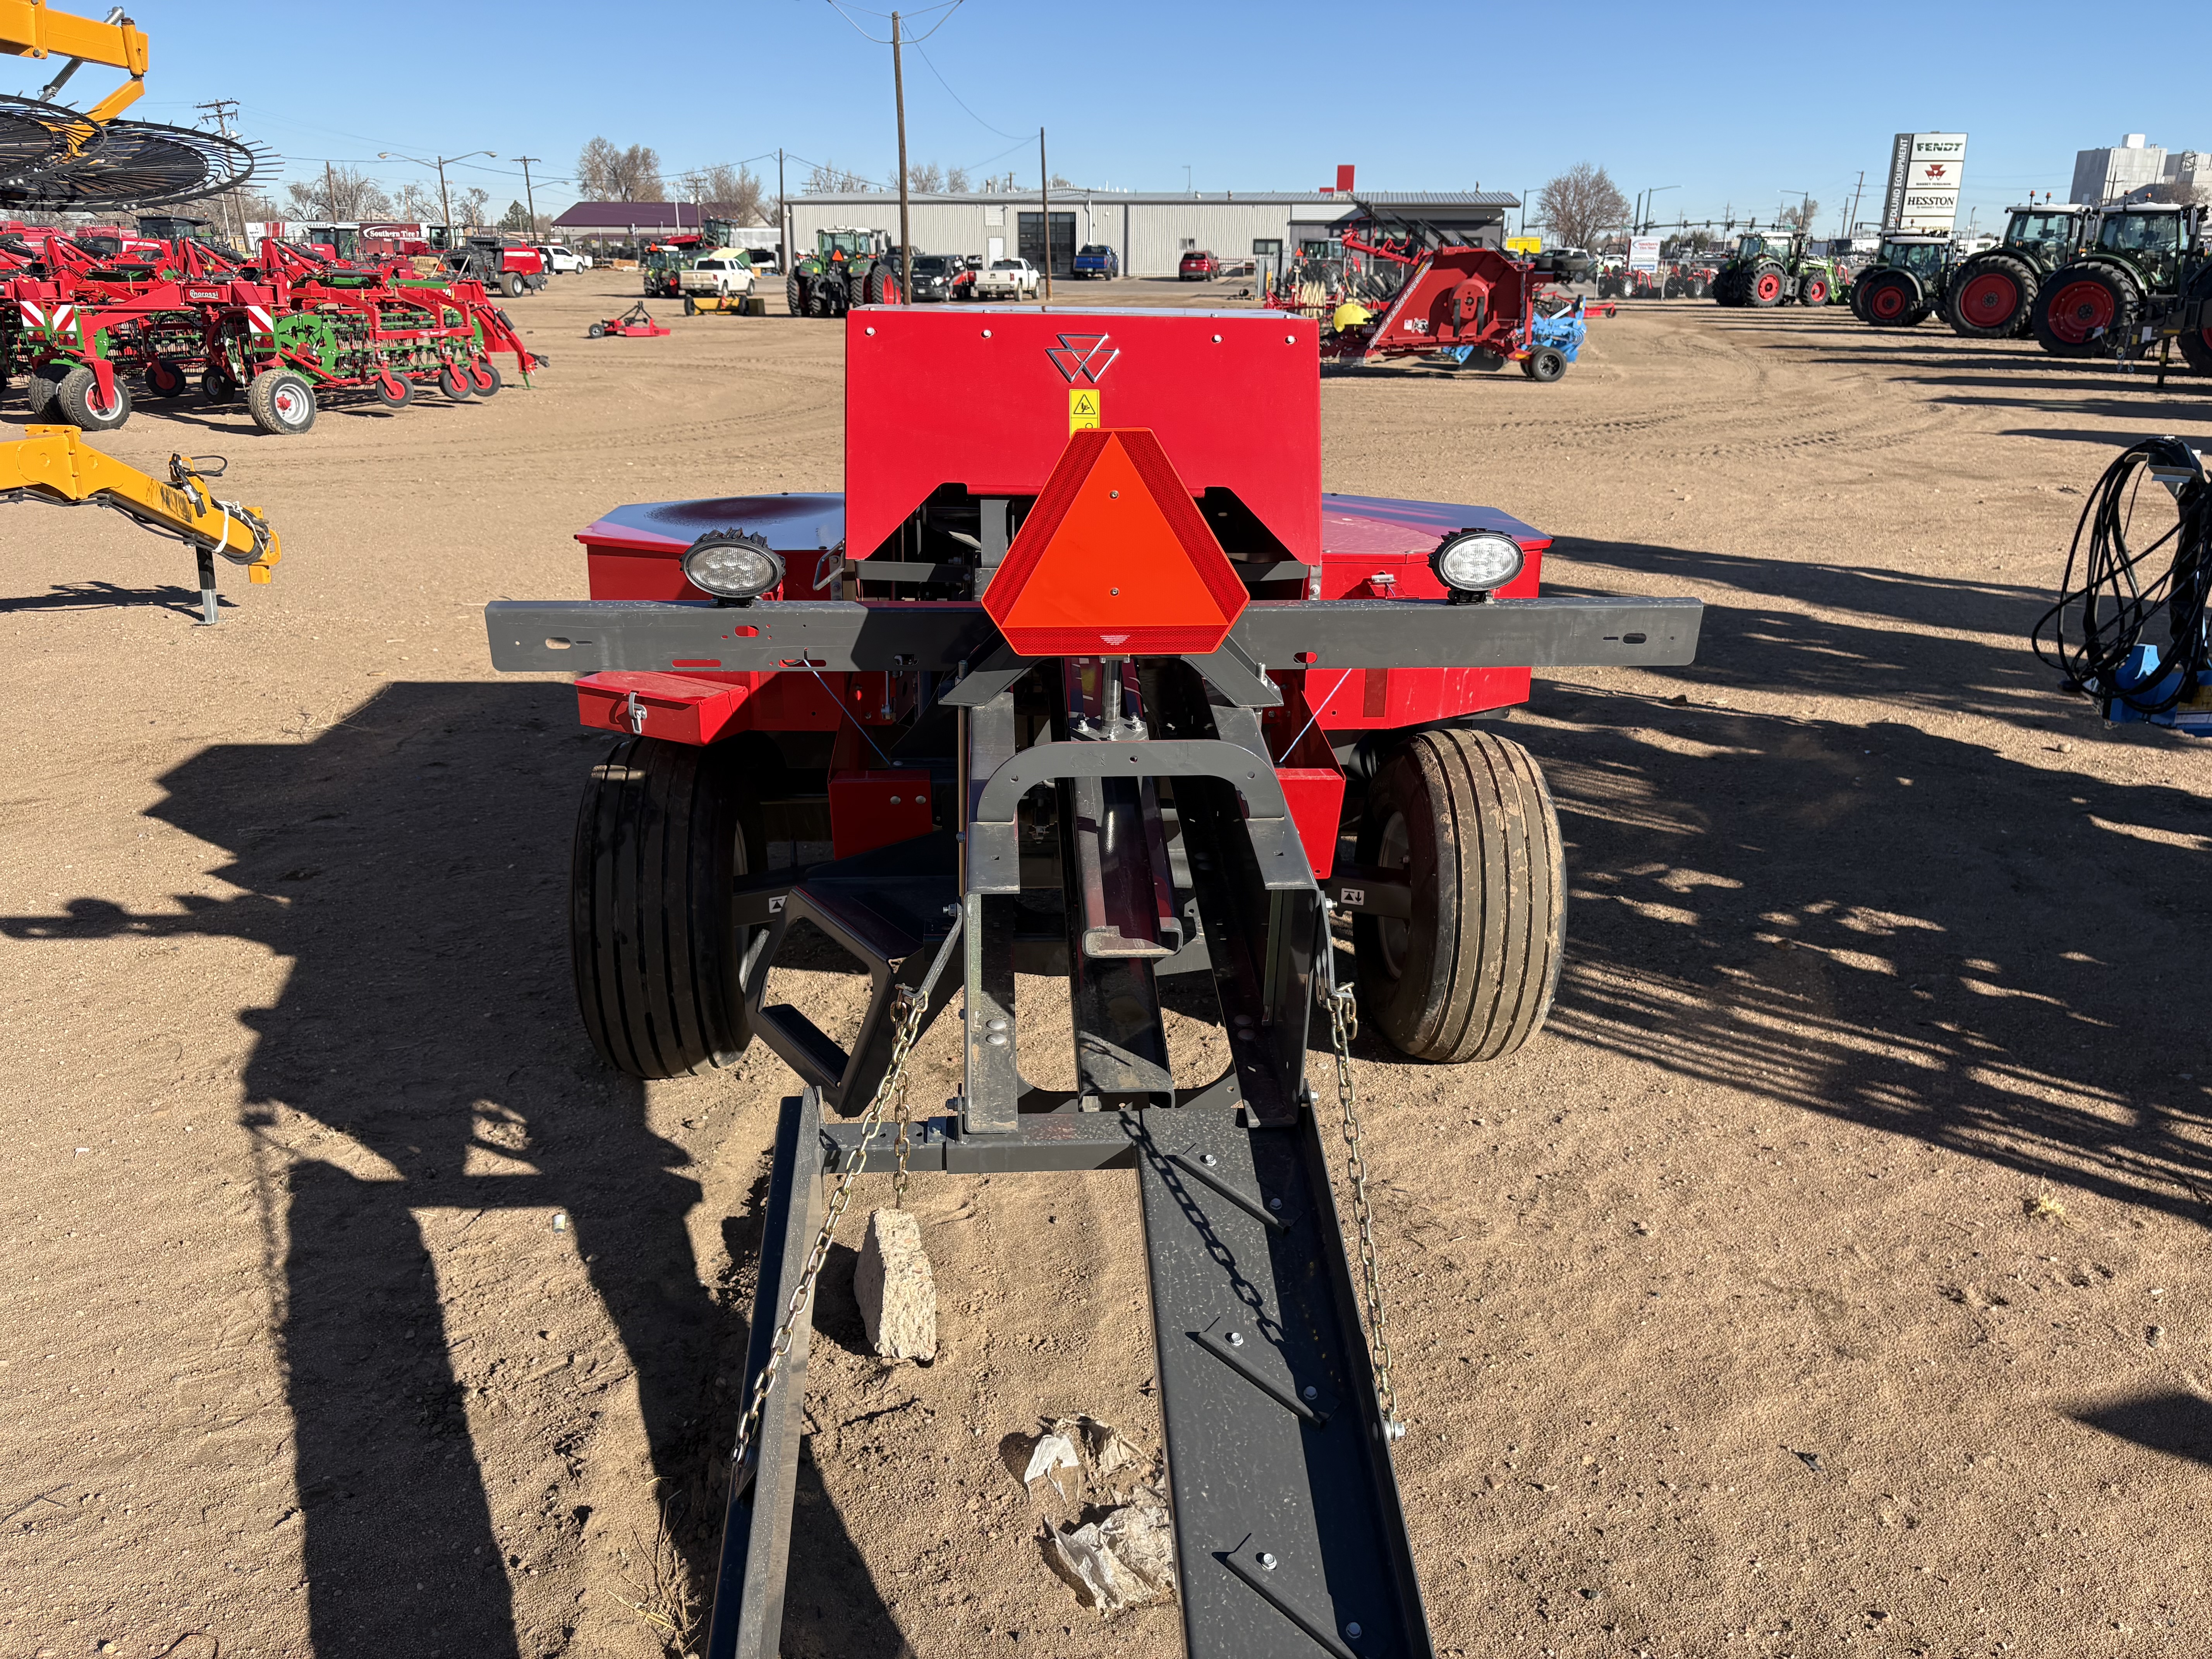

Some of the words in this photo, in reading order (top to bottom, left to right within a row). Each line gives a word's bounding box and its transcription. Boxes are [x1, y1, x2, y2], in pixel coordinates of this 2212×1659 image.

[1917, 143, 1963, 151] FENDT
[1894, 138, 1908, 187] EQUIPMENT
[1888, 188, 1901, 228] REDLUND
[1907, 196, 1955, 205] HESSTON
